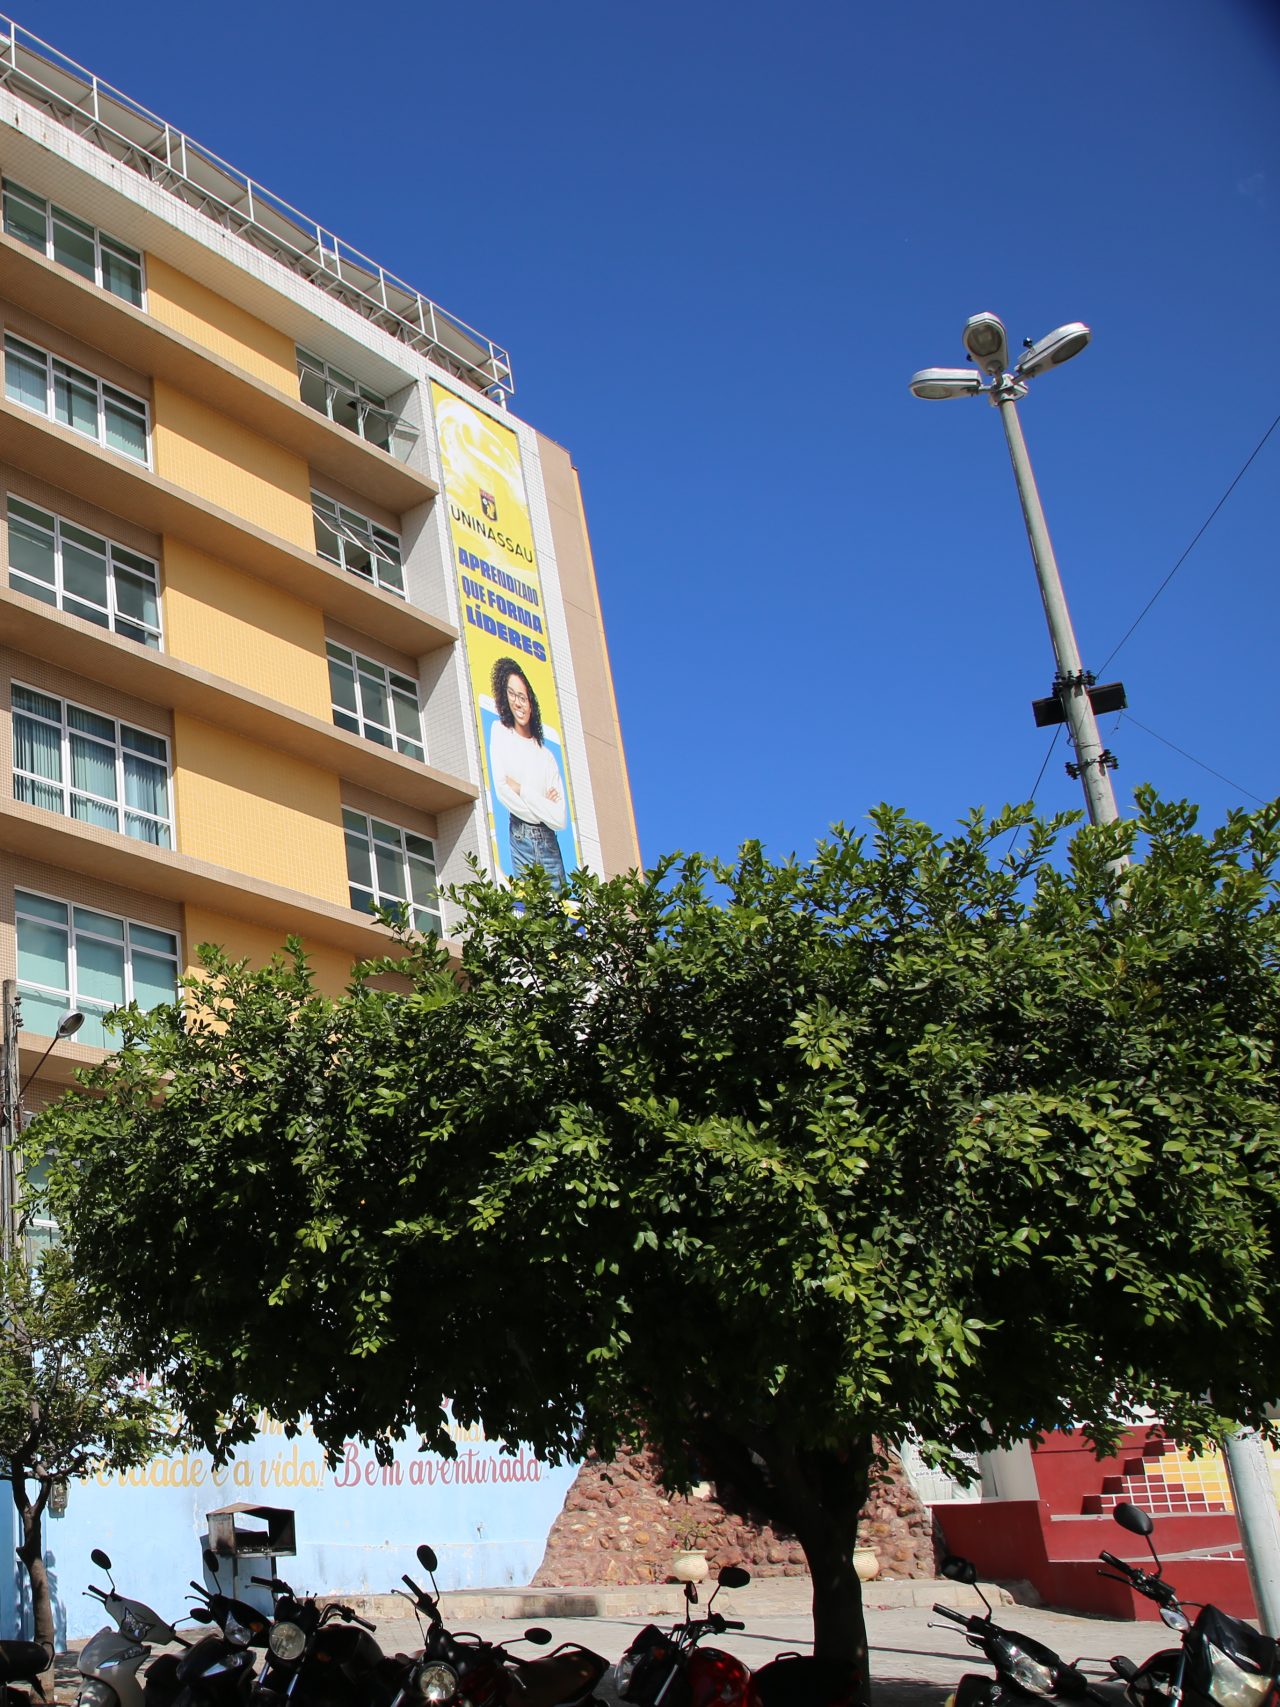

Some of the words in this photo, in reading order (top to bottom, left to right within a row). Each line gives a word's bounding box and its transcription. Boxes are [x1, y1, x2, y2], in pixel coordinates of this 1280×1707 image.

[450, 504, 534, 563] UNINASSAU
[458, 546, 539, 607] APRENDIZADO
[461, 575, 486, 605] QUE
[487, 589, 544, 635] FORMA
[465, 604, 547, 662] LÍDERES
[233, 1460, 254, 1487] a
[334, 1441, 404, 1488] Bem
[409, 1449, 542, 1486] aventurada
